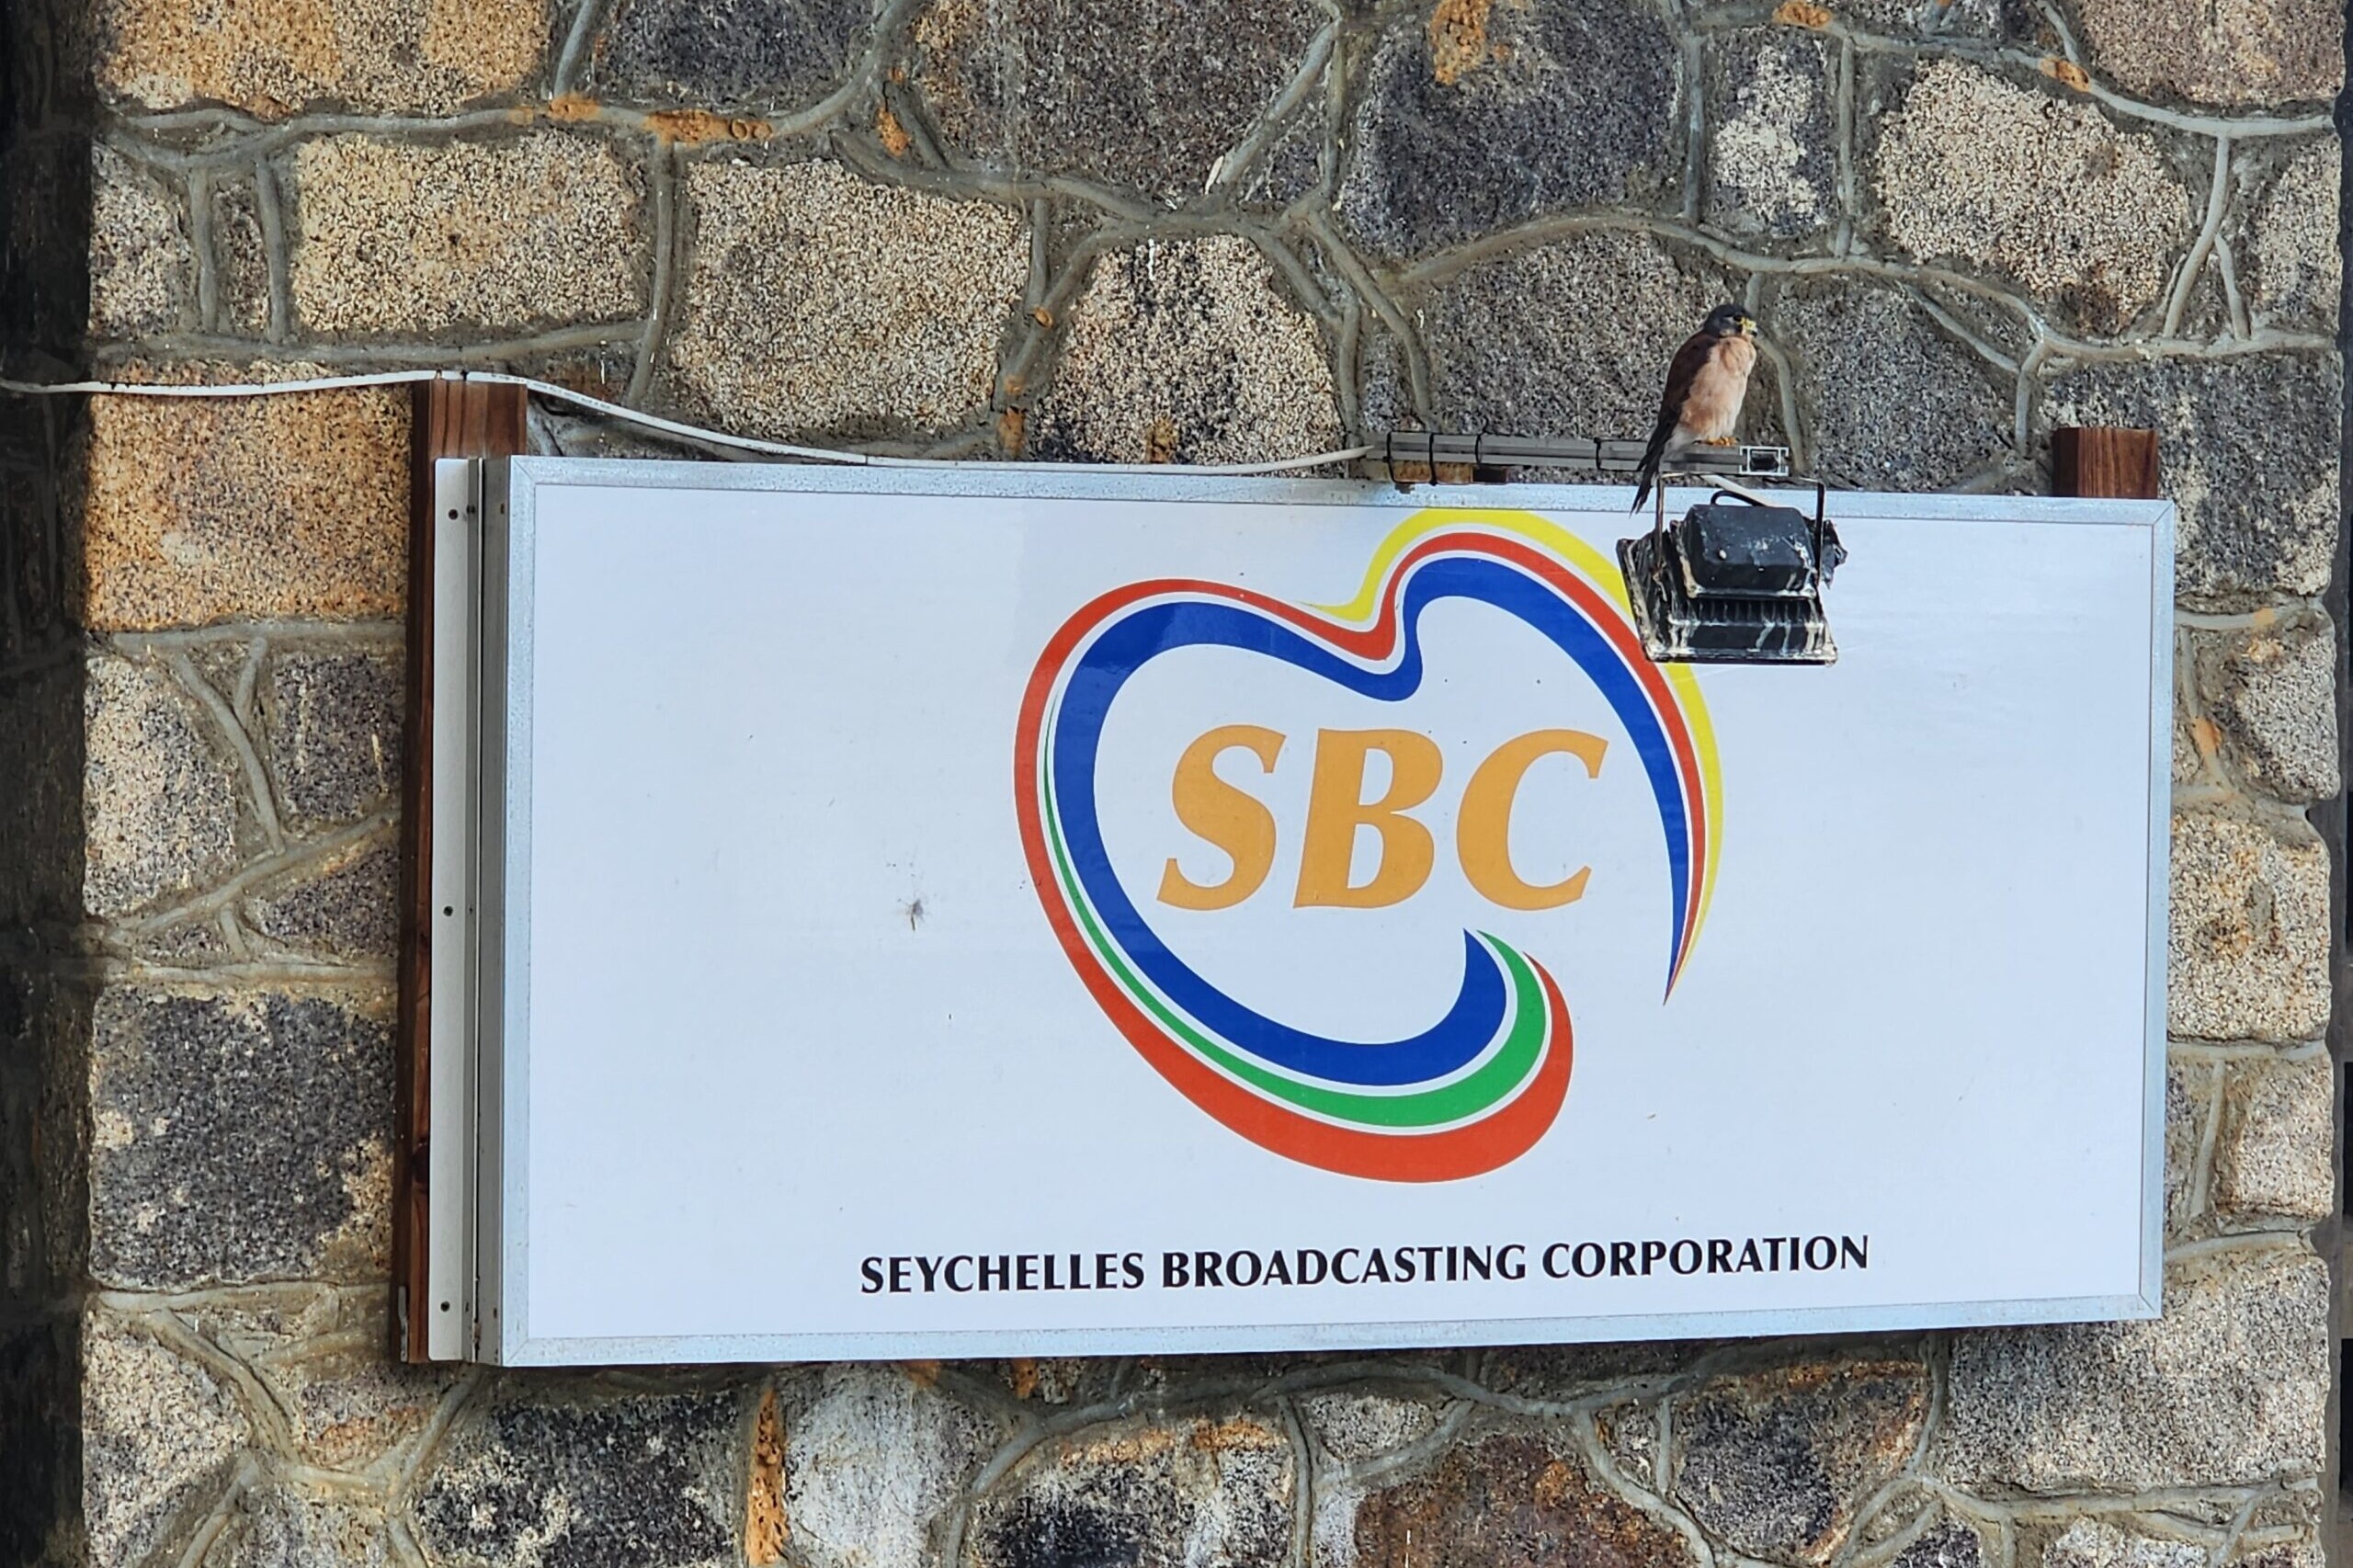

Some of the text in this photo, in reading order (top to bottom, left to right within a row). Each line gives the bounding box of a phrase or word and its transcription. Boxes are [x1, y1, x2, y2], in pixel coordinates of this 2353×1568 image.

[1157, 724, 1608, 912] SBC
[861, 1234, 1869, 1294] SEYCHELLES BROADCASTING CORPORATION
